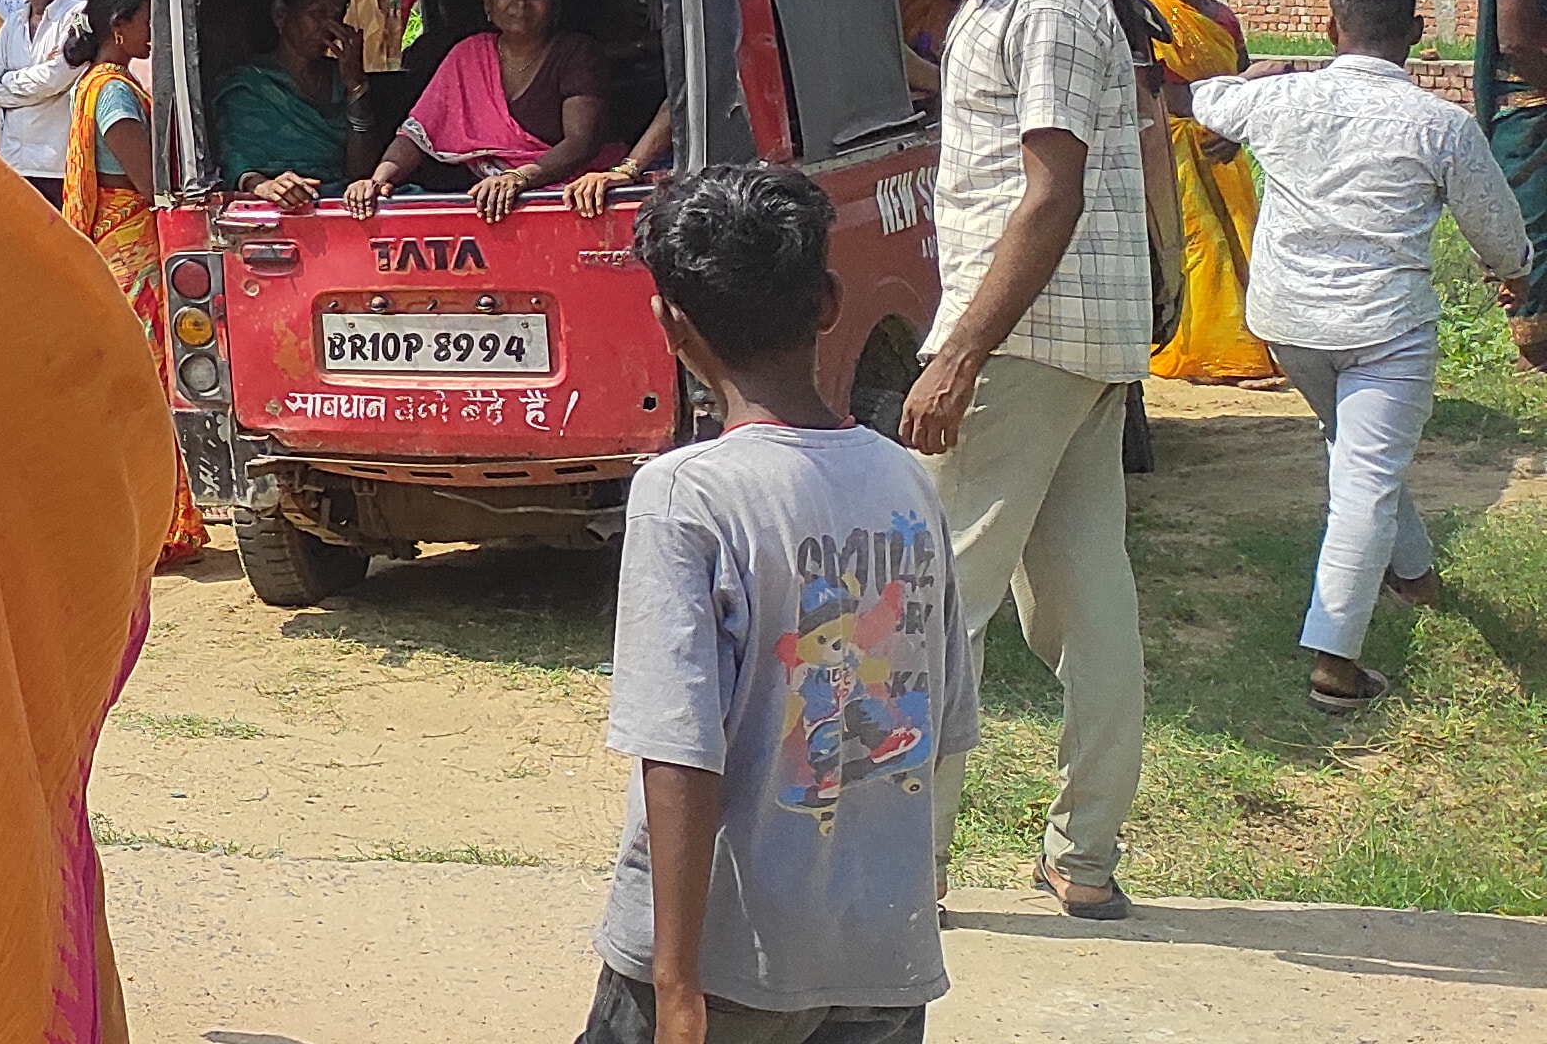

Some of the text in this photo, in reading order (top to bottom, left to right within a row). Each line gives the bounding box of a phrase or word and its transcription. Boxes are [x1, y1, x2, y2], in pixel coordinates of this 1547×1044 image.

[876, 170, 918, 236] NEW
[369, 236, 489, 274] TATA
[433, 332, 526, 363] 8994
[285, 391, 387, 423] सावधान
